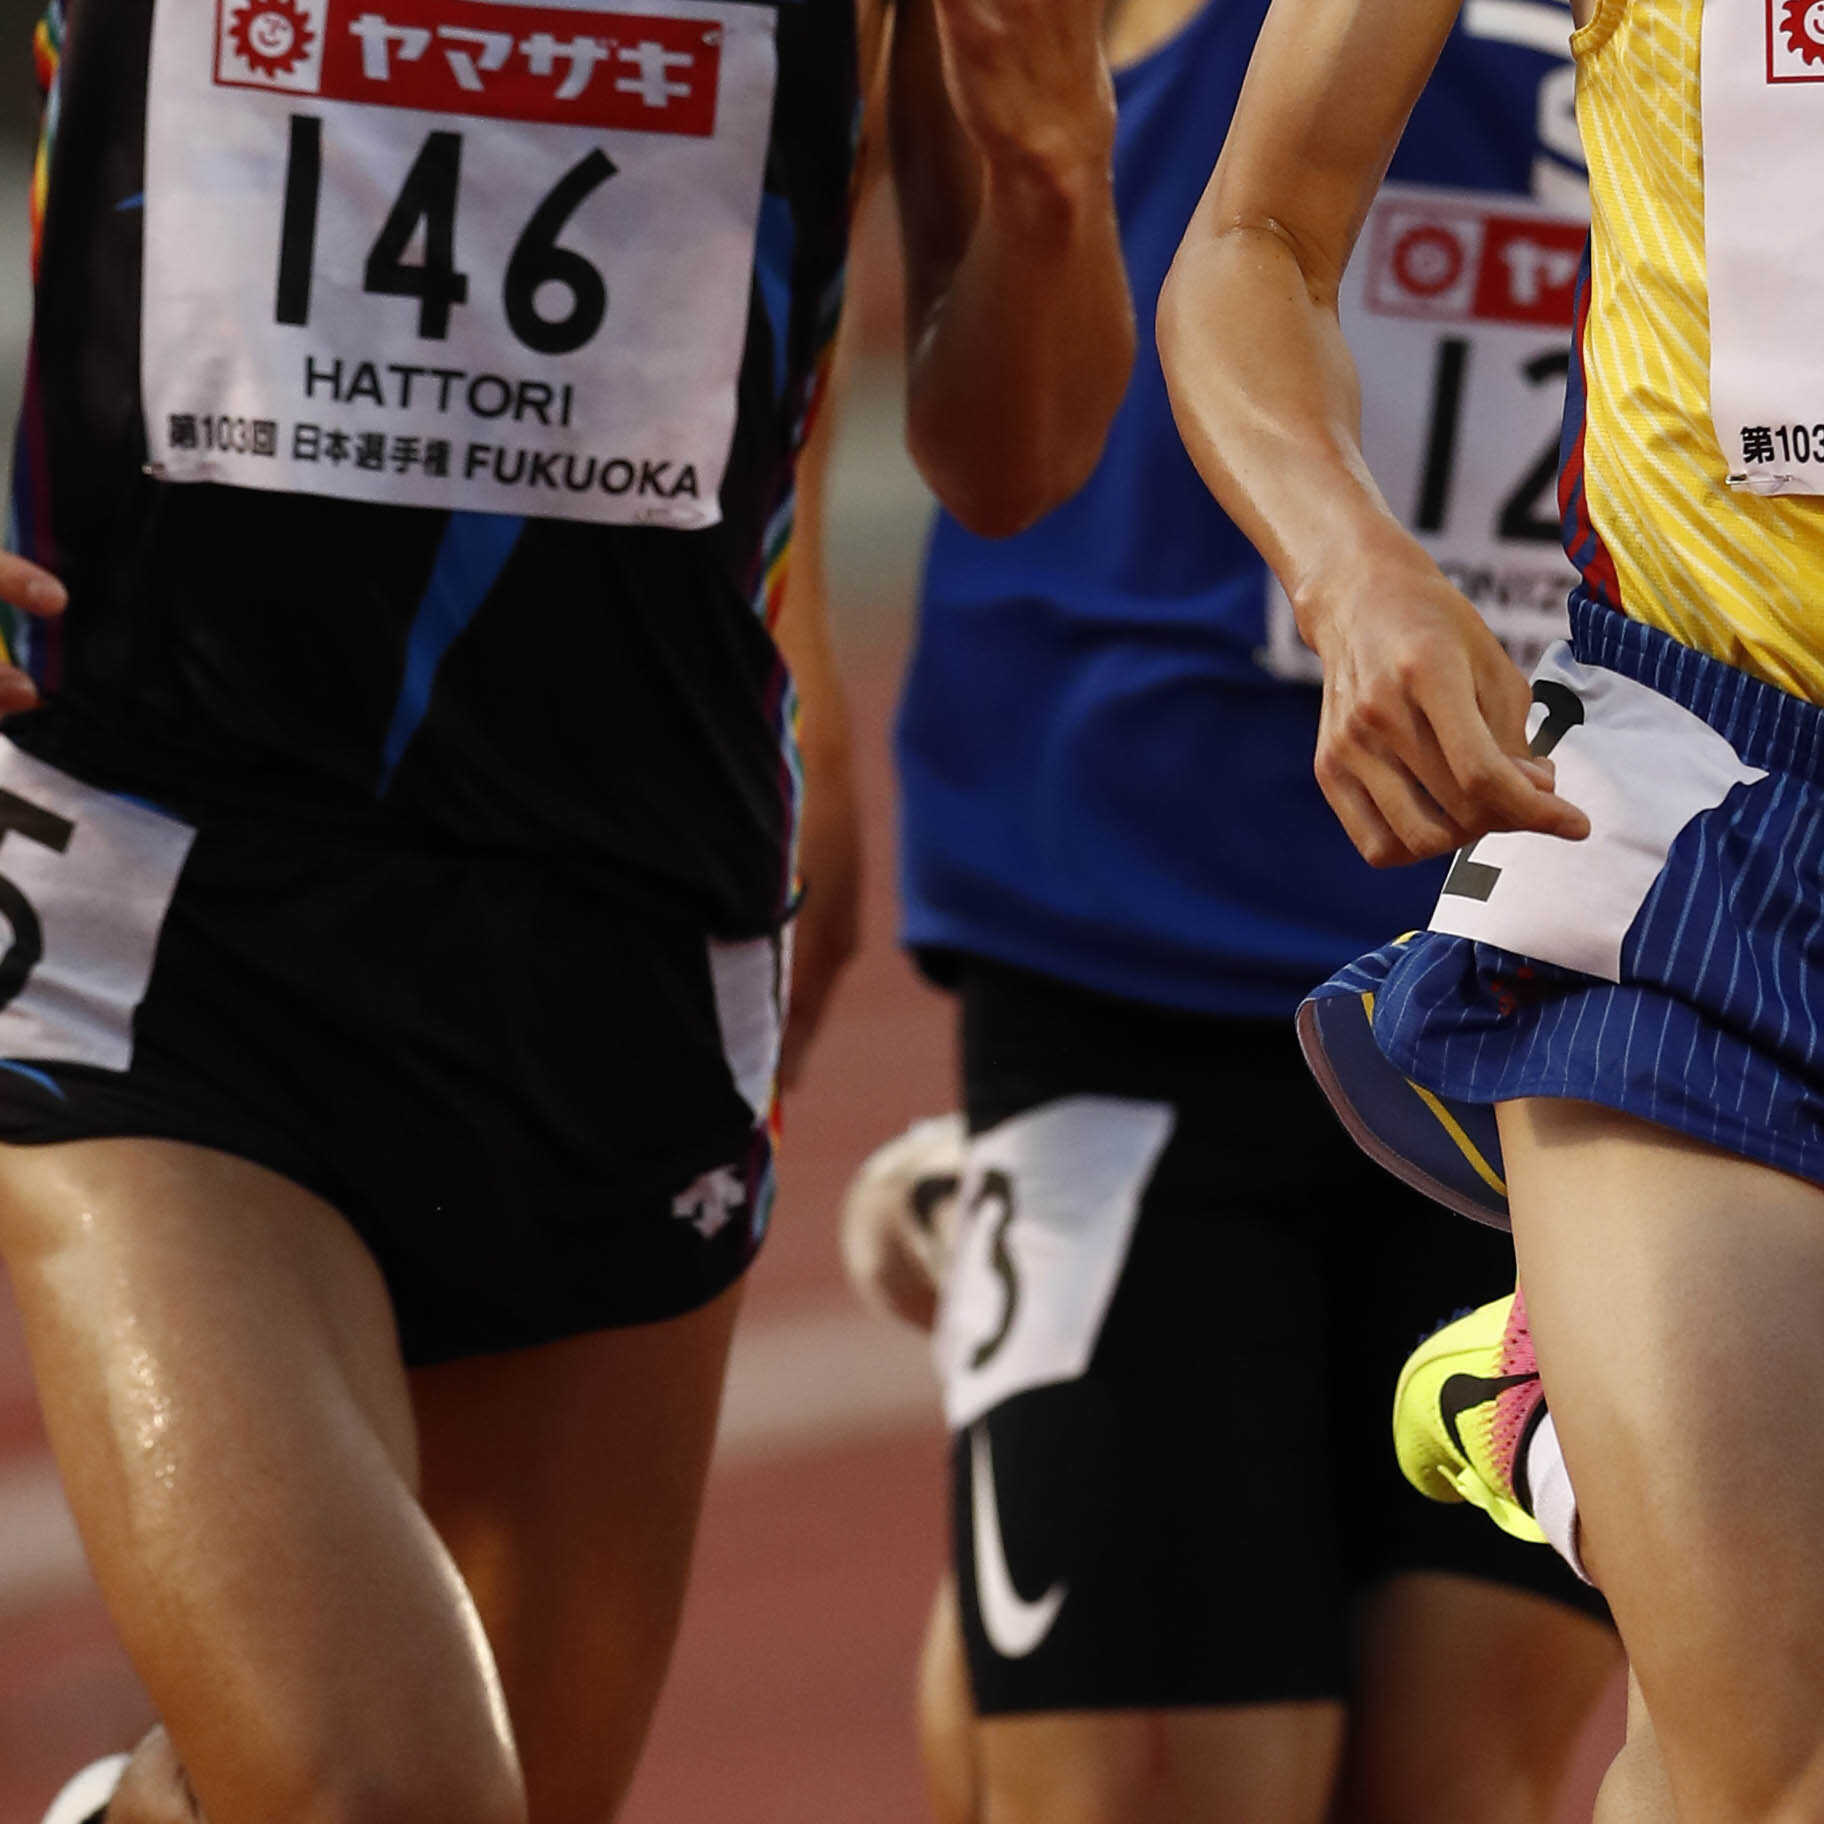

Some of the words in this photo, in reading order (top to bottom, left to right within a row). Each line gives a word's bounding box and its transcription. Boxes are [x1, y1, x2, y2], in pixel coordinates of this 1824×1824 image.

[349, 12, 694, 109] ヤマザキ
[274, 114, 620, 354] 146
[305, 356, 572, 427] HATTORI
[1415, 336, 1568, 542] 12
[463, 444, 699, 499] FUKUOKA
